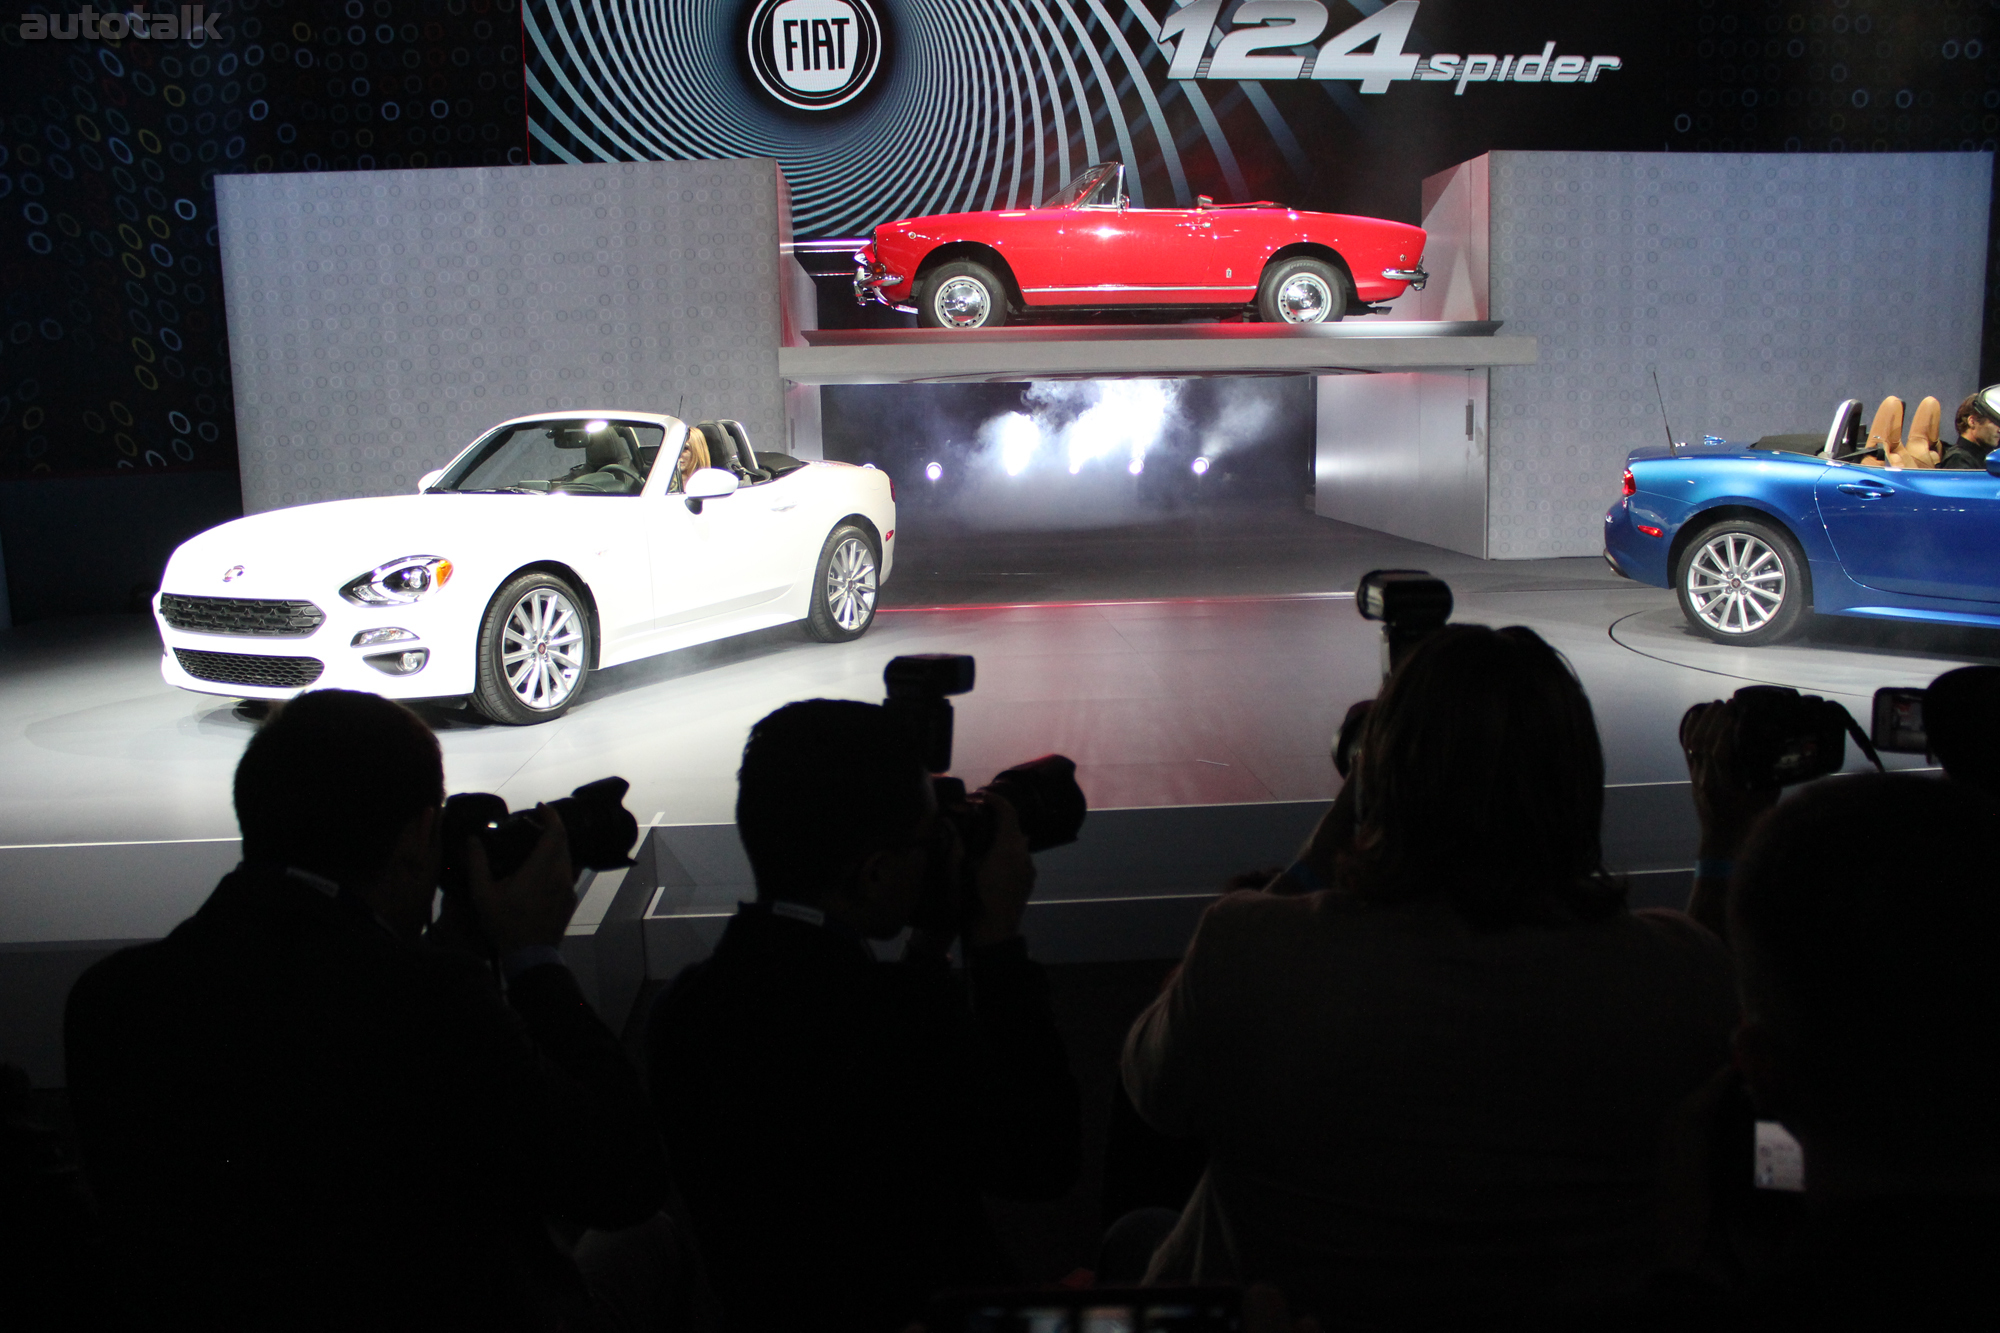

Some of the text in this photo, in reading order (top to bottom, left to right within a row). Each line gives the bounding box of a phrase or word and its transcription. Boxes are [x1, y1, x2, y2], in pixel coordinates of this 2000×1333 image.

[783, 17, 850, 71] FIAT
[1158, 0, 1622, 96] 124 spider
